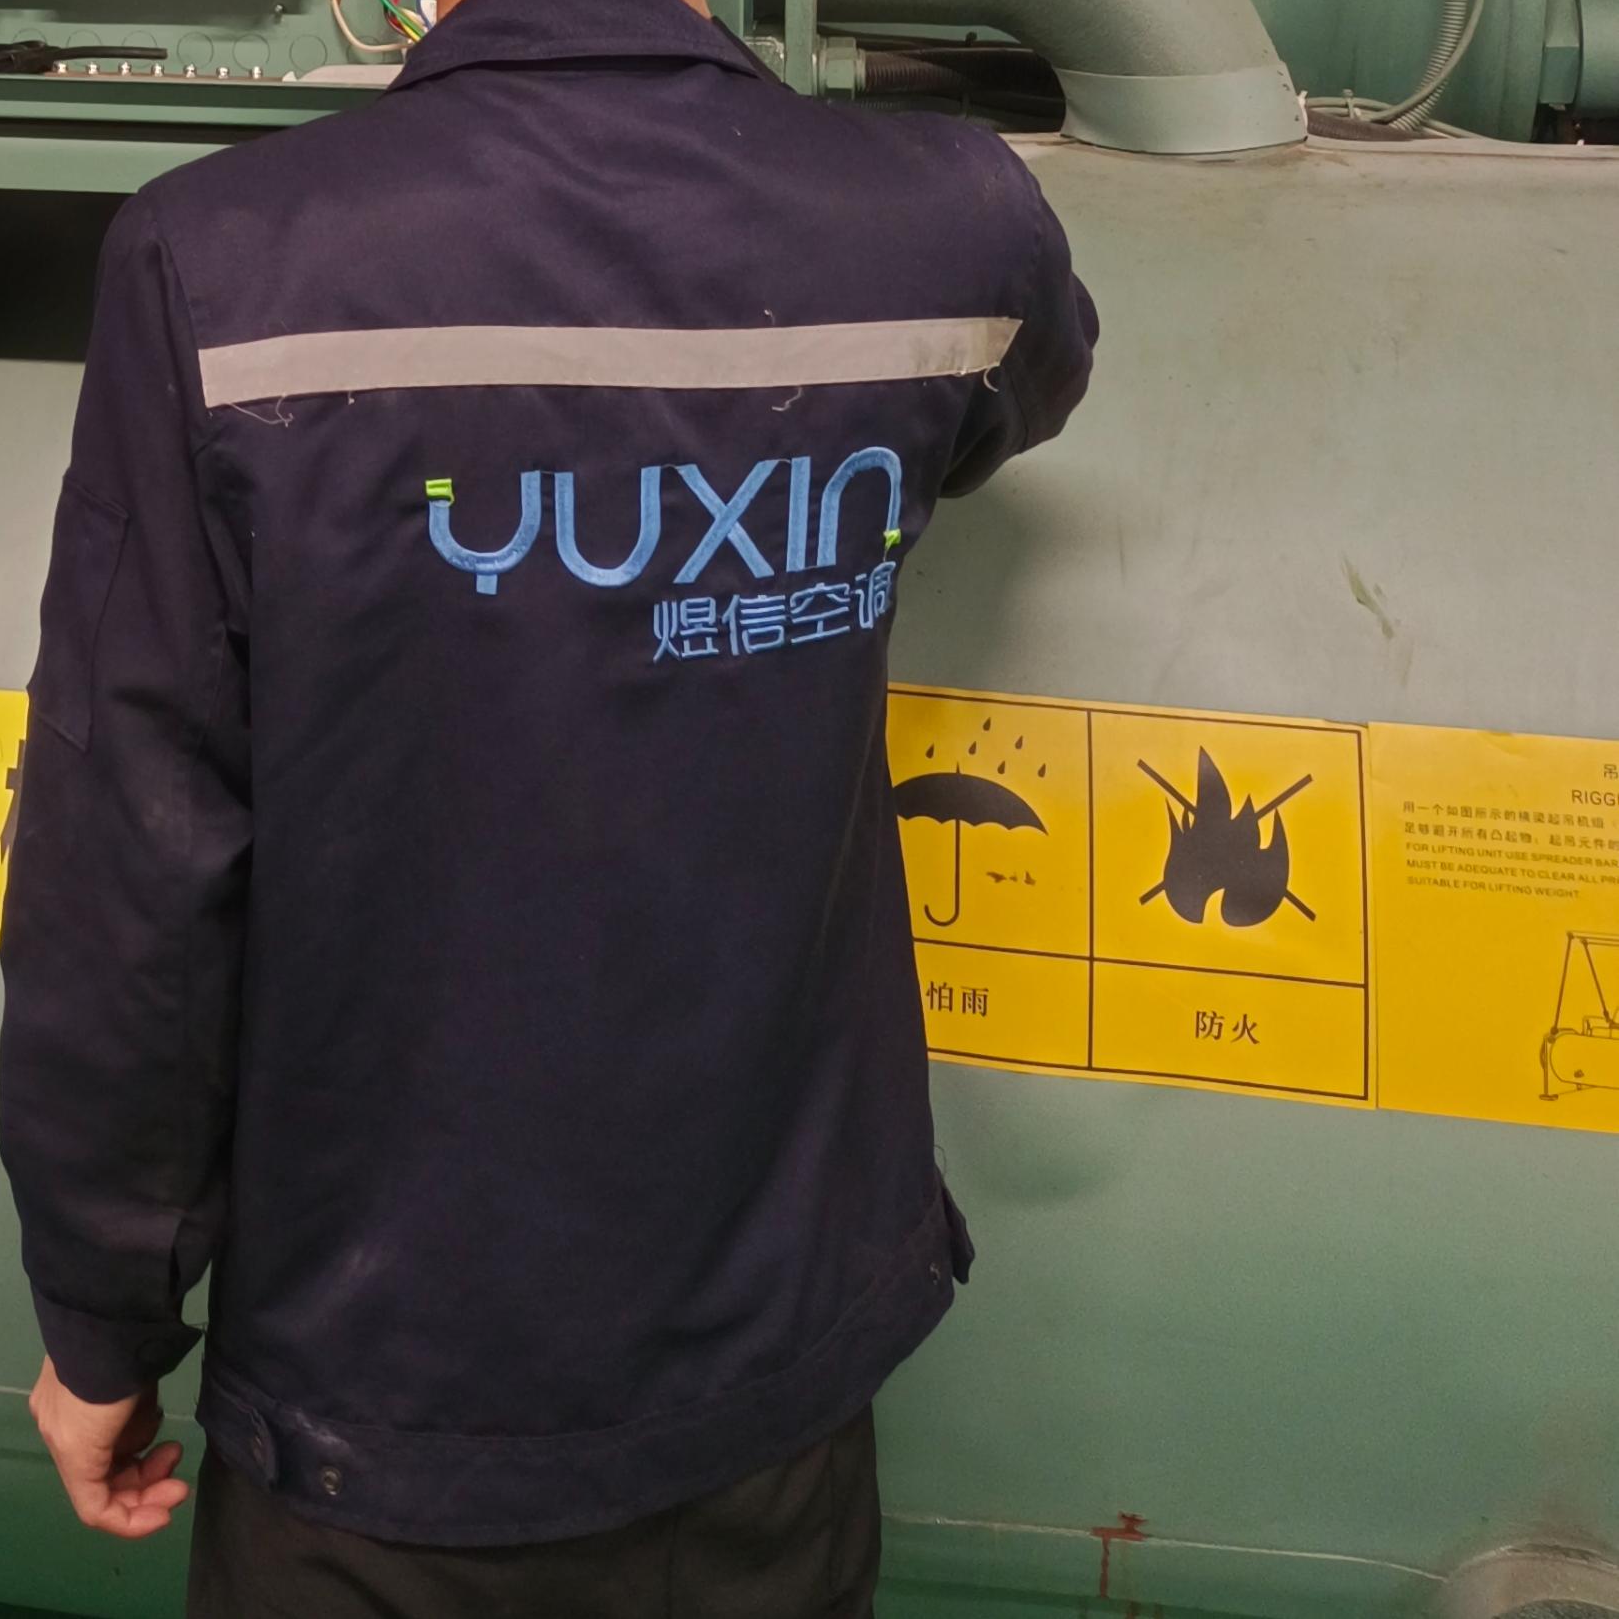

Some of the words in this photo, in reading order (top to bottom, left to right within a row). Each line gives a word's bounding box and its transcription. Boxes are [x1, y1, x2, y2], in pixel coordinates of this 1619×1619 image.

[653, 560, 896, 663] 煜信空调
[1406, 842, 1429, 852] FOR
[1431, 844, 1475, 857] LIFTING
[1477, 848, 1503, 858] UNIT
[1505, 851, 1528, 861] USE
[1531, 852, 1593, 865] SPREADER
[1406, 859, 1437, 870] MUST
[1440, 861, 1455, 871] BE
[1457, 864, 1518, 877] ADEQUATE
[1520, 868, 1535, 878] TO
[1537, 870, 1575, 882] CLEAR
[1578, 873, 1599, 884] ALL
[1406, 875, 1461, 889] SUITABLE
[1463, 880, 1487, 891] FOR
[1489, 882, 1532, 896] LIFTING
[926, 980, 989, 1017] 怕雨
[1195, 1010, 1260, 1045] 防火
